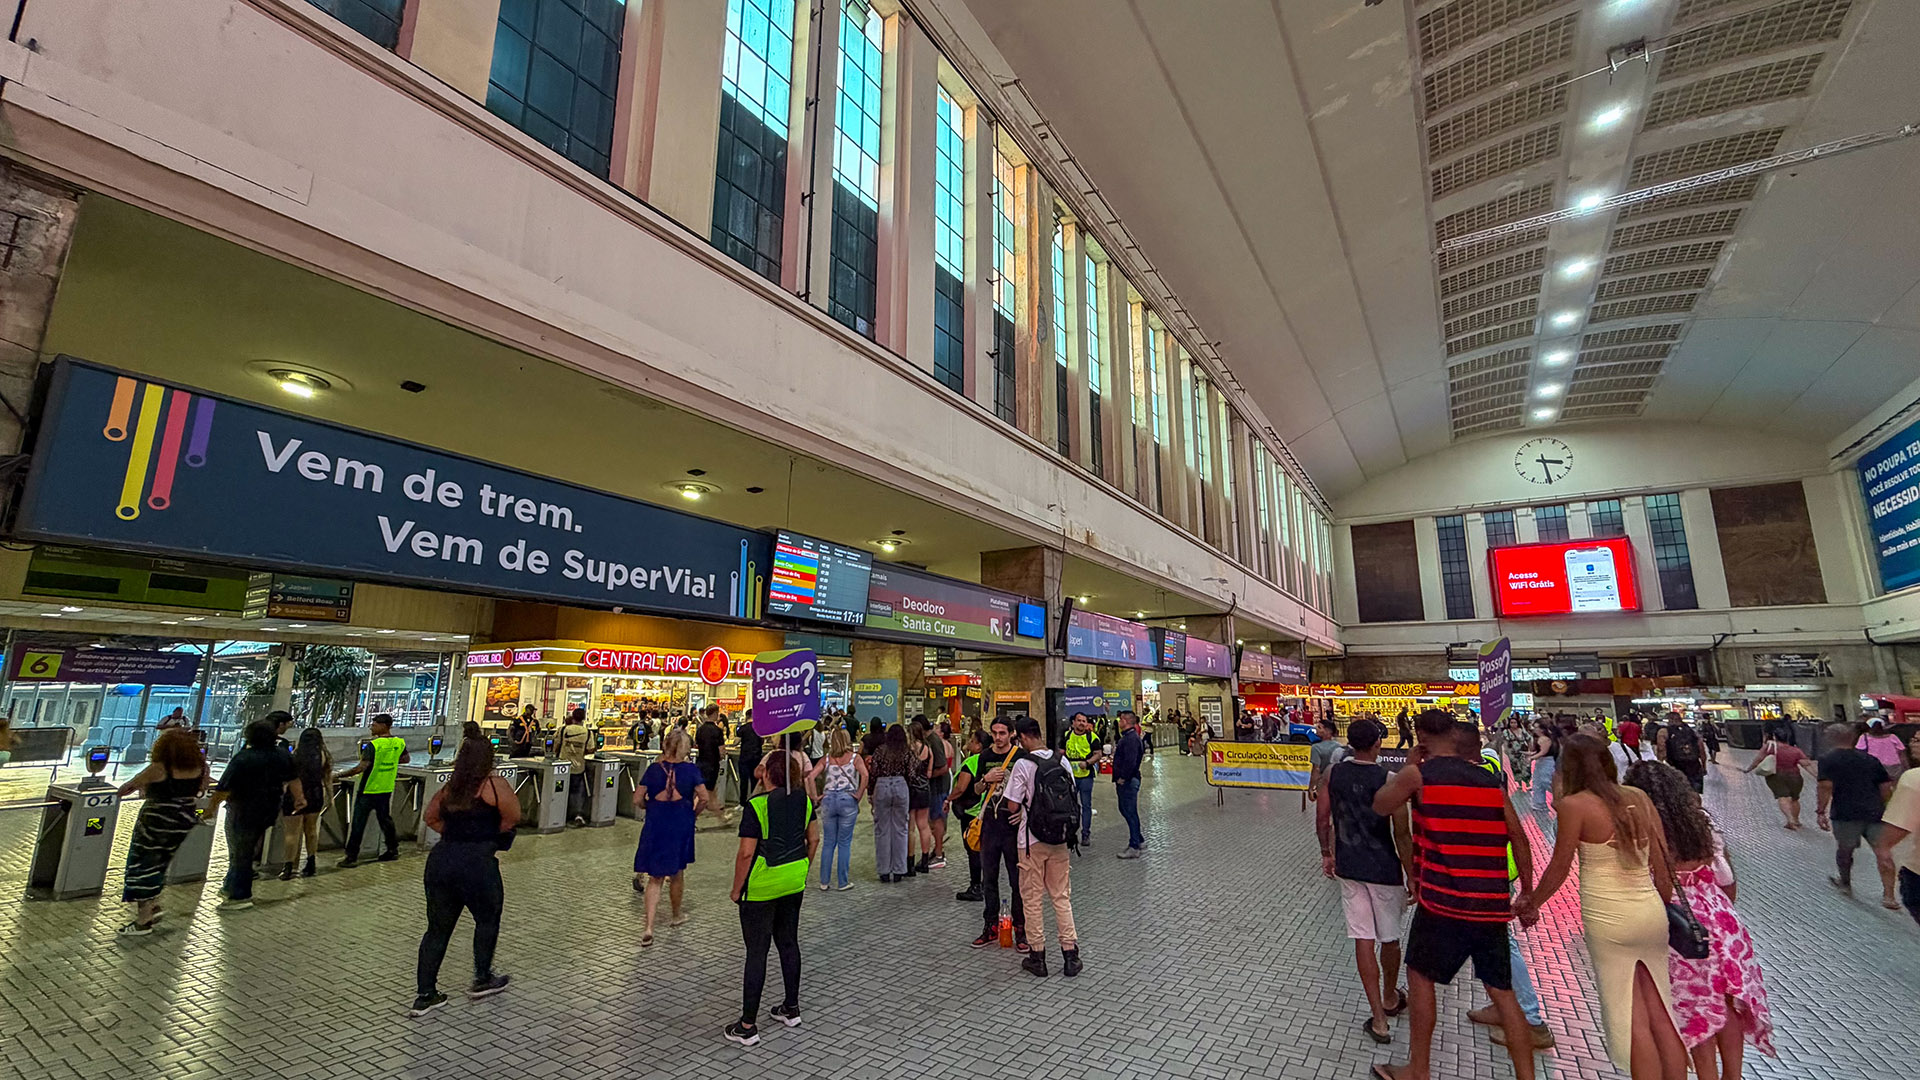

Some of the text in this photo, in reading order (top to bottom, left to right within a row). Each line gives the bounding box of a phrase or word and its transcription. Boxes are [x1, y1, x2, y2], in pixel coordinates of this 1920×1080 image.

[1864, 467, 1877, 483] NO
[1877, 450, 1908, 475] POUPA
[257, 430, 583, 534] Vem de trem.
[1869, 481, 1885, 497] VOCÊ
[1884, 470, 1909, 489] RESOLVE
[378, 515, 716, 599] Vem de SuperVia!
[1508, 572, 1538, 580] Acesso
[1509, 580, 1555, 590] WiFi Grátis
[287, 596, 314, 604] Belford
[903, 596, 945, 615] Deodoro
[843, 611, 864, 623] 17:11
[903, 615, 956, 635] Santa Cruz
[1005, 622, 1012, 637] 2
[30, 656, 49, 673] 6
[467, 651, 541, 664] CENTRAL RIO LANCHES
[585, 649, 660, 670] CENTRAL
[665, 655, 692, 671] RIO
[1480, 656, 1503, 675] Posso
[756, 667, 800, 682] Posso
[1370, 683, 1423, 695] TONY'S
[1481, 673, 1504, 694] ajudar
[756, 683, 800, 702] ajudar
[1226, 750, 1309, 762] Circulação suspensa
[87, 796, 113, 807] 04
